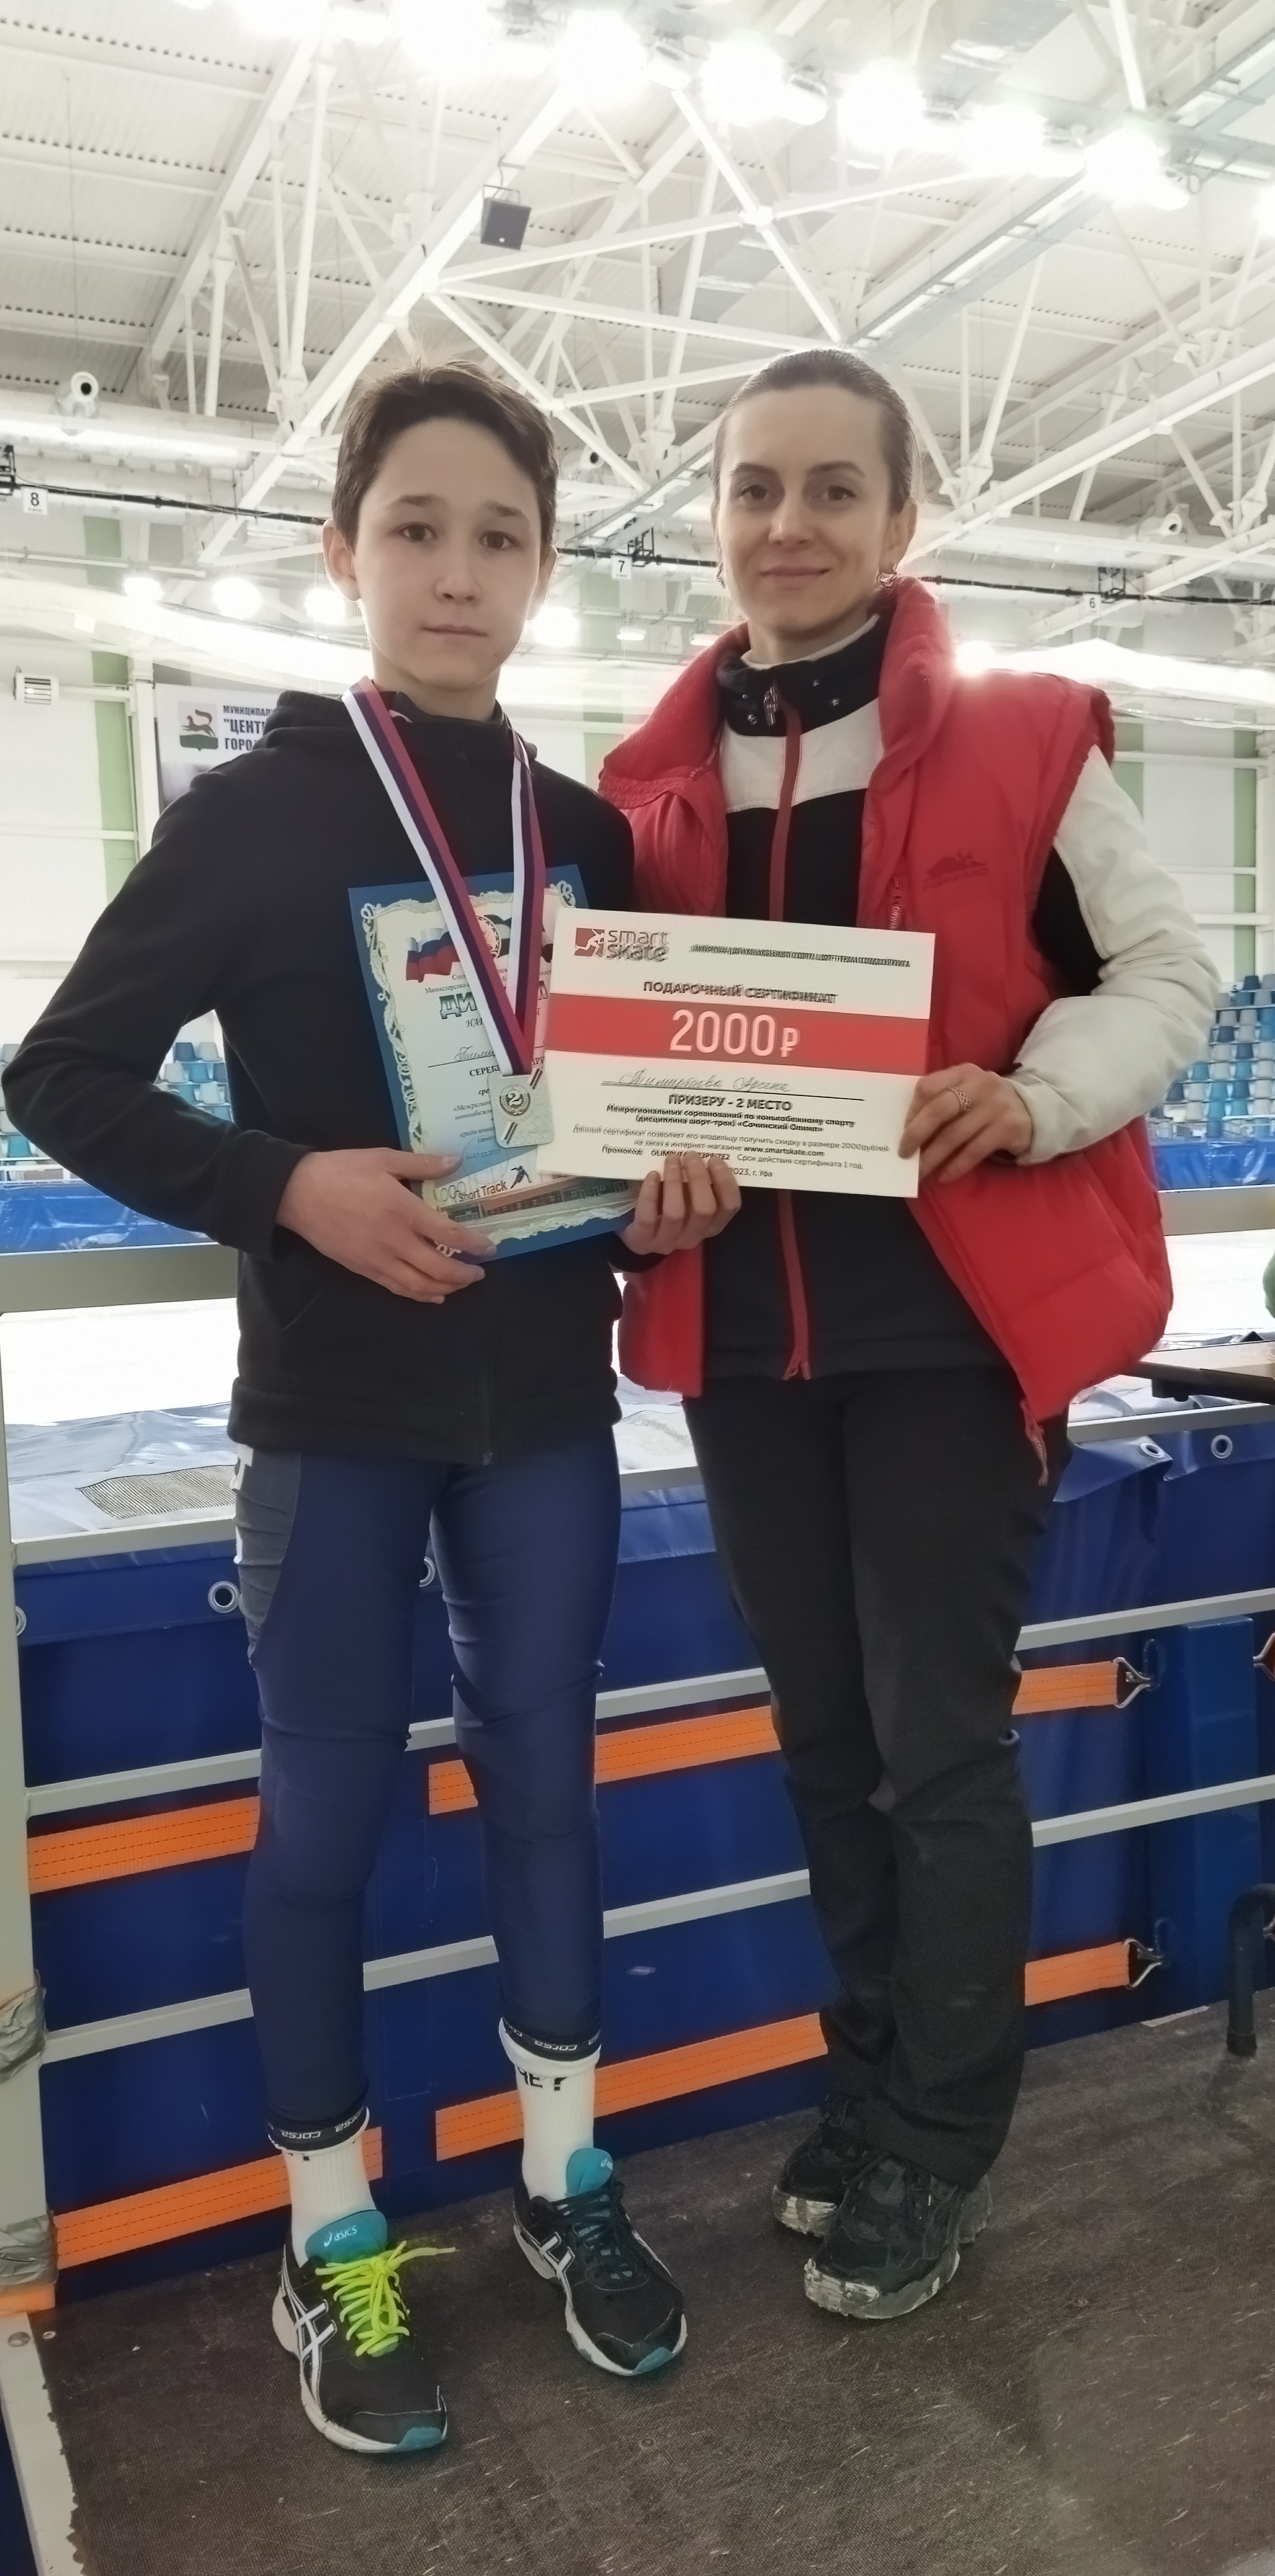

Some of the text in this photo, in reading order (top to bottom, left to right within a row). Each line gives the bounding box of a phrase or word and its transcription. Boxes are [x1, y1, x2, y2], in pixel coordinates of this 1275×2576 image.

[31, 492, 39, 506] 8
[618, 560, 625, 573] 7
[1090, 598, 1095, 609] 6
[223, 705, 273, 716] МУНИЦИПАЛ
[225, 738, 257, 751] ГОРО
[607, 930, 670, 945] smart
[606, 943, 670, 962] skate
[643, 980, 839, 1003] ПОДАРОЧНЫЙ СЕРТИФИКАТ
[507, 1090, 522, 1106] 2
[668, 1094, 726, 1107] ПРИЗЕРУ
[735, 1098, 745, 1108] 2
[746, 1098, 793, 1111] МЕСТО
[607, 1103, 683, 1115] Межрегиональных
[684, 1108, 744, 1119] соревнований
[756, 1113, 825, 1126] конькобежному
[825, 1119, 856, 1128] спорту
[636, 1113, 688, 1124] (дисциплина
[688, 1117, 737, 1128] шорт-трек)
[737, 1121, 789, 1130] «Сочинский
[737, 1153, 757, 1162] Срок
[744, 1146, 825, 1157] www.smartskate.com
[759, 1170, 773, 1178] Уфа
[480, 1180, 507, 1196] Track
[534, 2039, 578, 2051] corsa
[281, 2130, 321, 2139] corsa
[334, 2224, 358, 2241] asics
